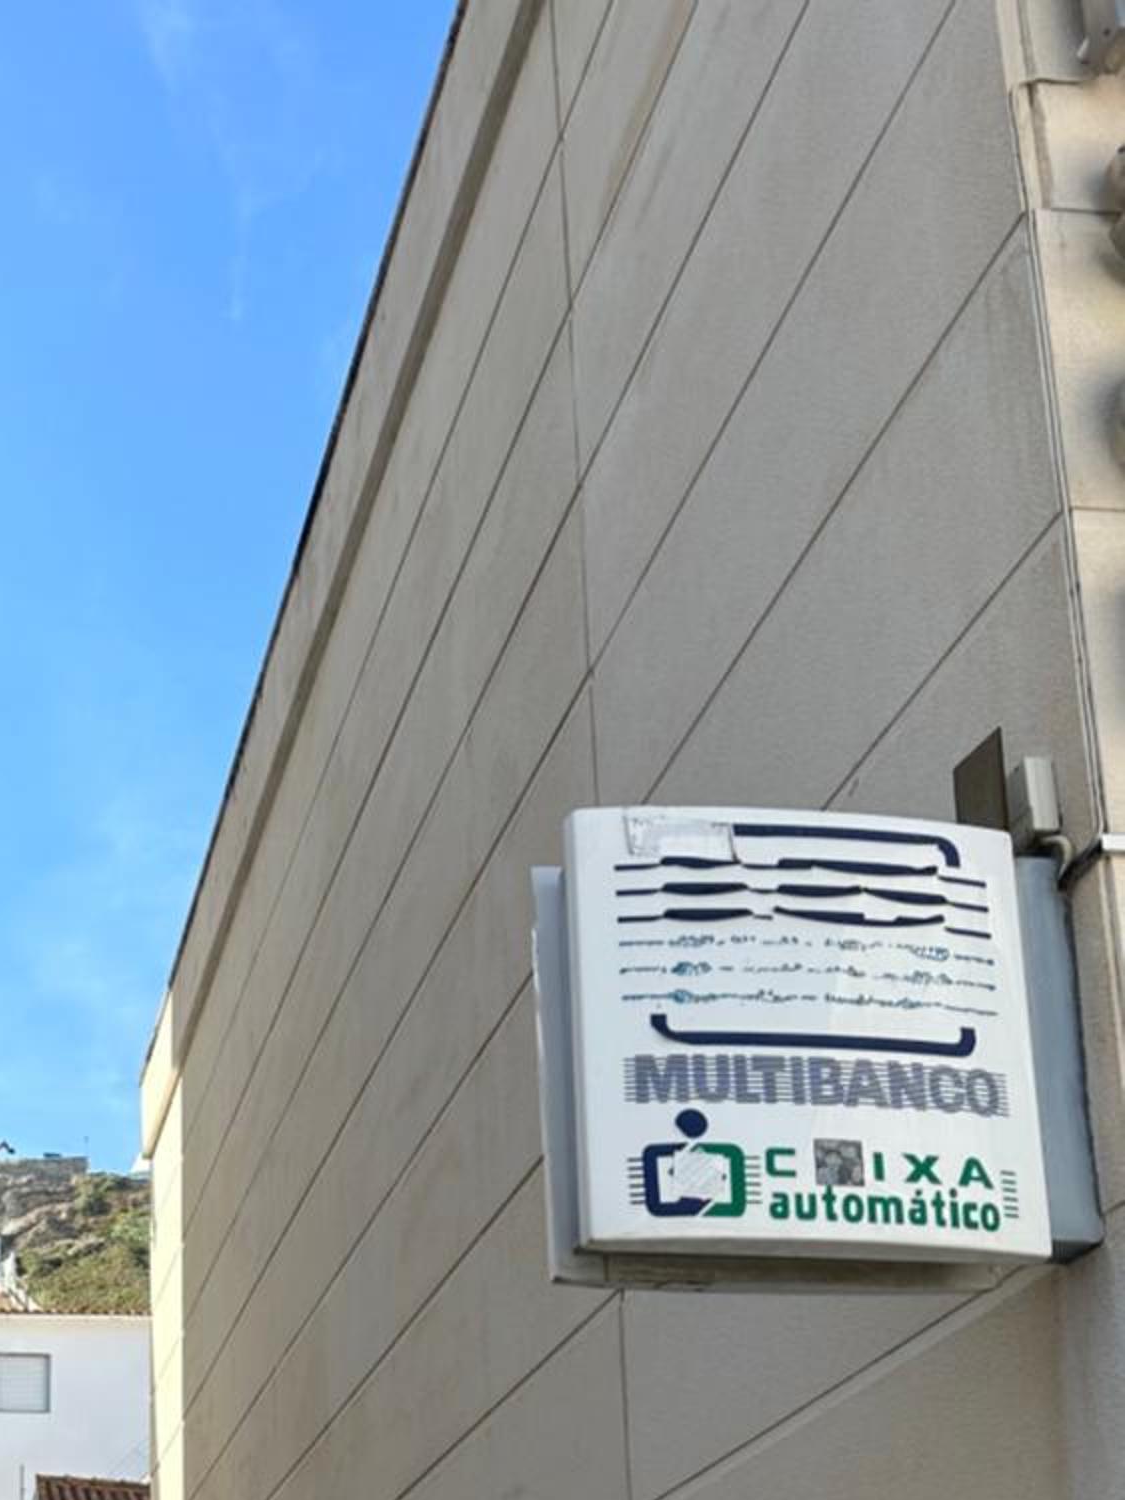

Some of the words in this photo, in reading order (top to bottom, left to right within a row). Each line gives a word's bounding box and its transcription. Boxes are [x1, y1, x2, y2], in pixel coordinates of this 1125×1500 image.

[632, 1053, 1002, 1117] MULTIBANCO
[765, 1145, 994, 1190] CIXA
[769, 1186, 1001, 1232] automático
